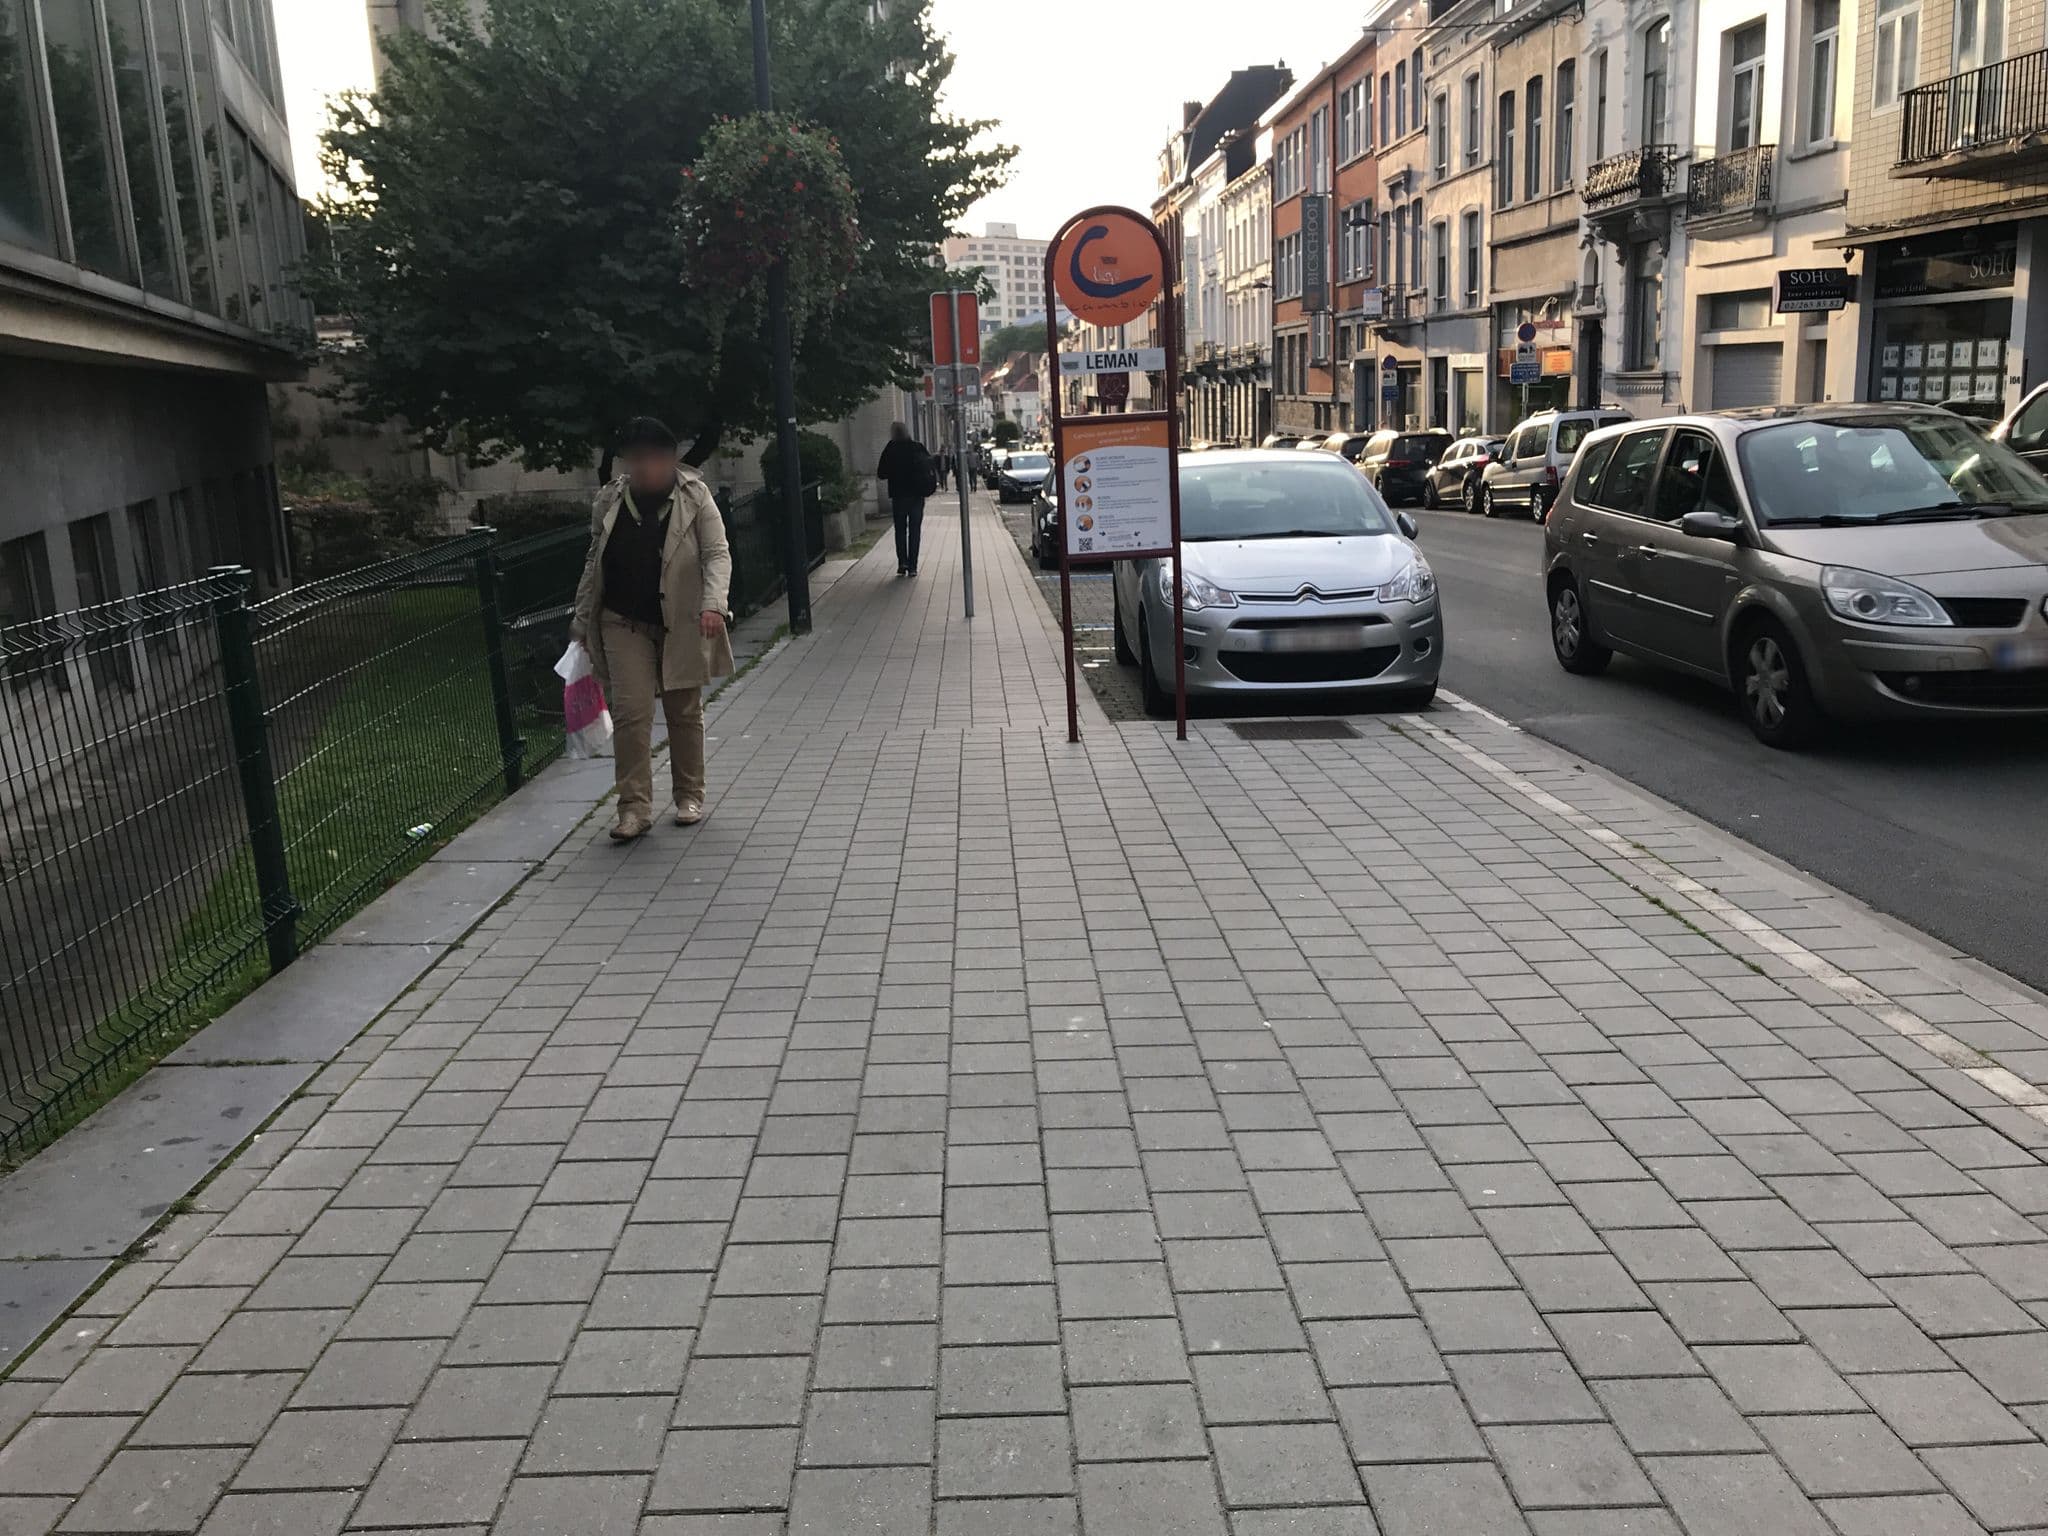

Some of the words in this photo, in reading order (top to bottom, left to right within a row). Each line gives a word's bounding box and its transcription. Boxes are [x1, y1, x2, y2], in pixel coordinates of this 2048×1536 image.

[1790, 270, 1836, 285] SOHO
[1086, 352, 1138, 370] LEMAN
[2009, 375, 2021, 385] 104
